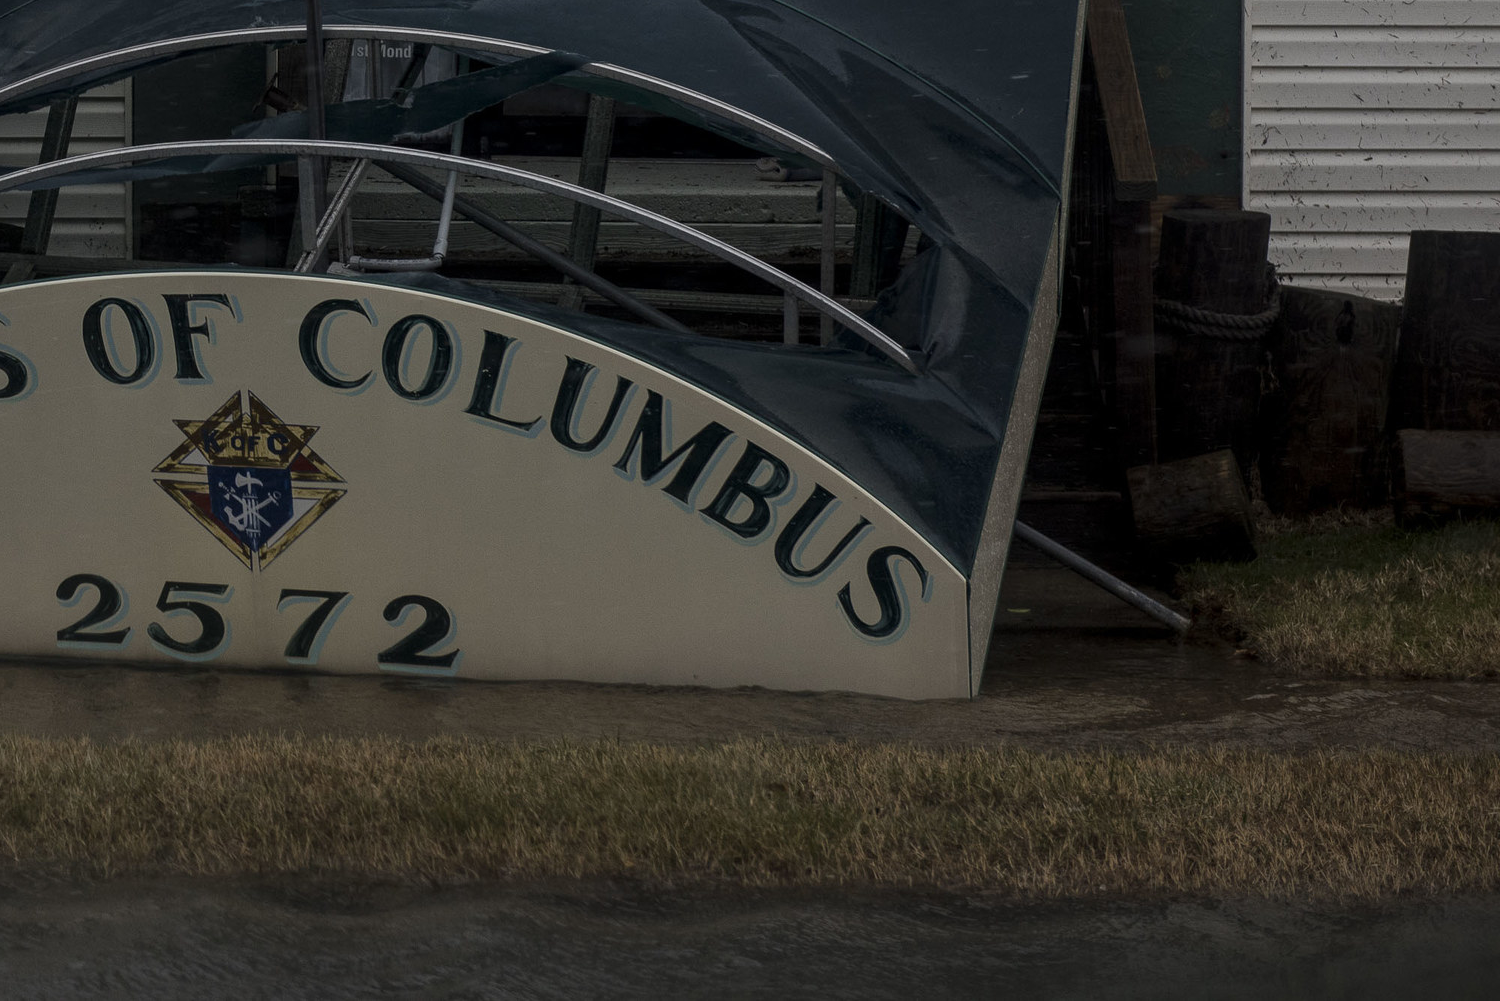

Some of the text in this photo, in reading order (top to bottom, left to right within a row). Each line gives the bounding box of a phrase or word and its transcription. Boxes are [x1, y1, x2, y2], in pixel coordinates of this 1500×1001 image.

[81, 292, 241, 389] OF
[298, 297, 933, 642] COLUMBUS
[203, 429, 221, 454] K
[267, 432, 290, 456] C
[56, 572, 463, 673] 2572
